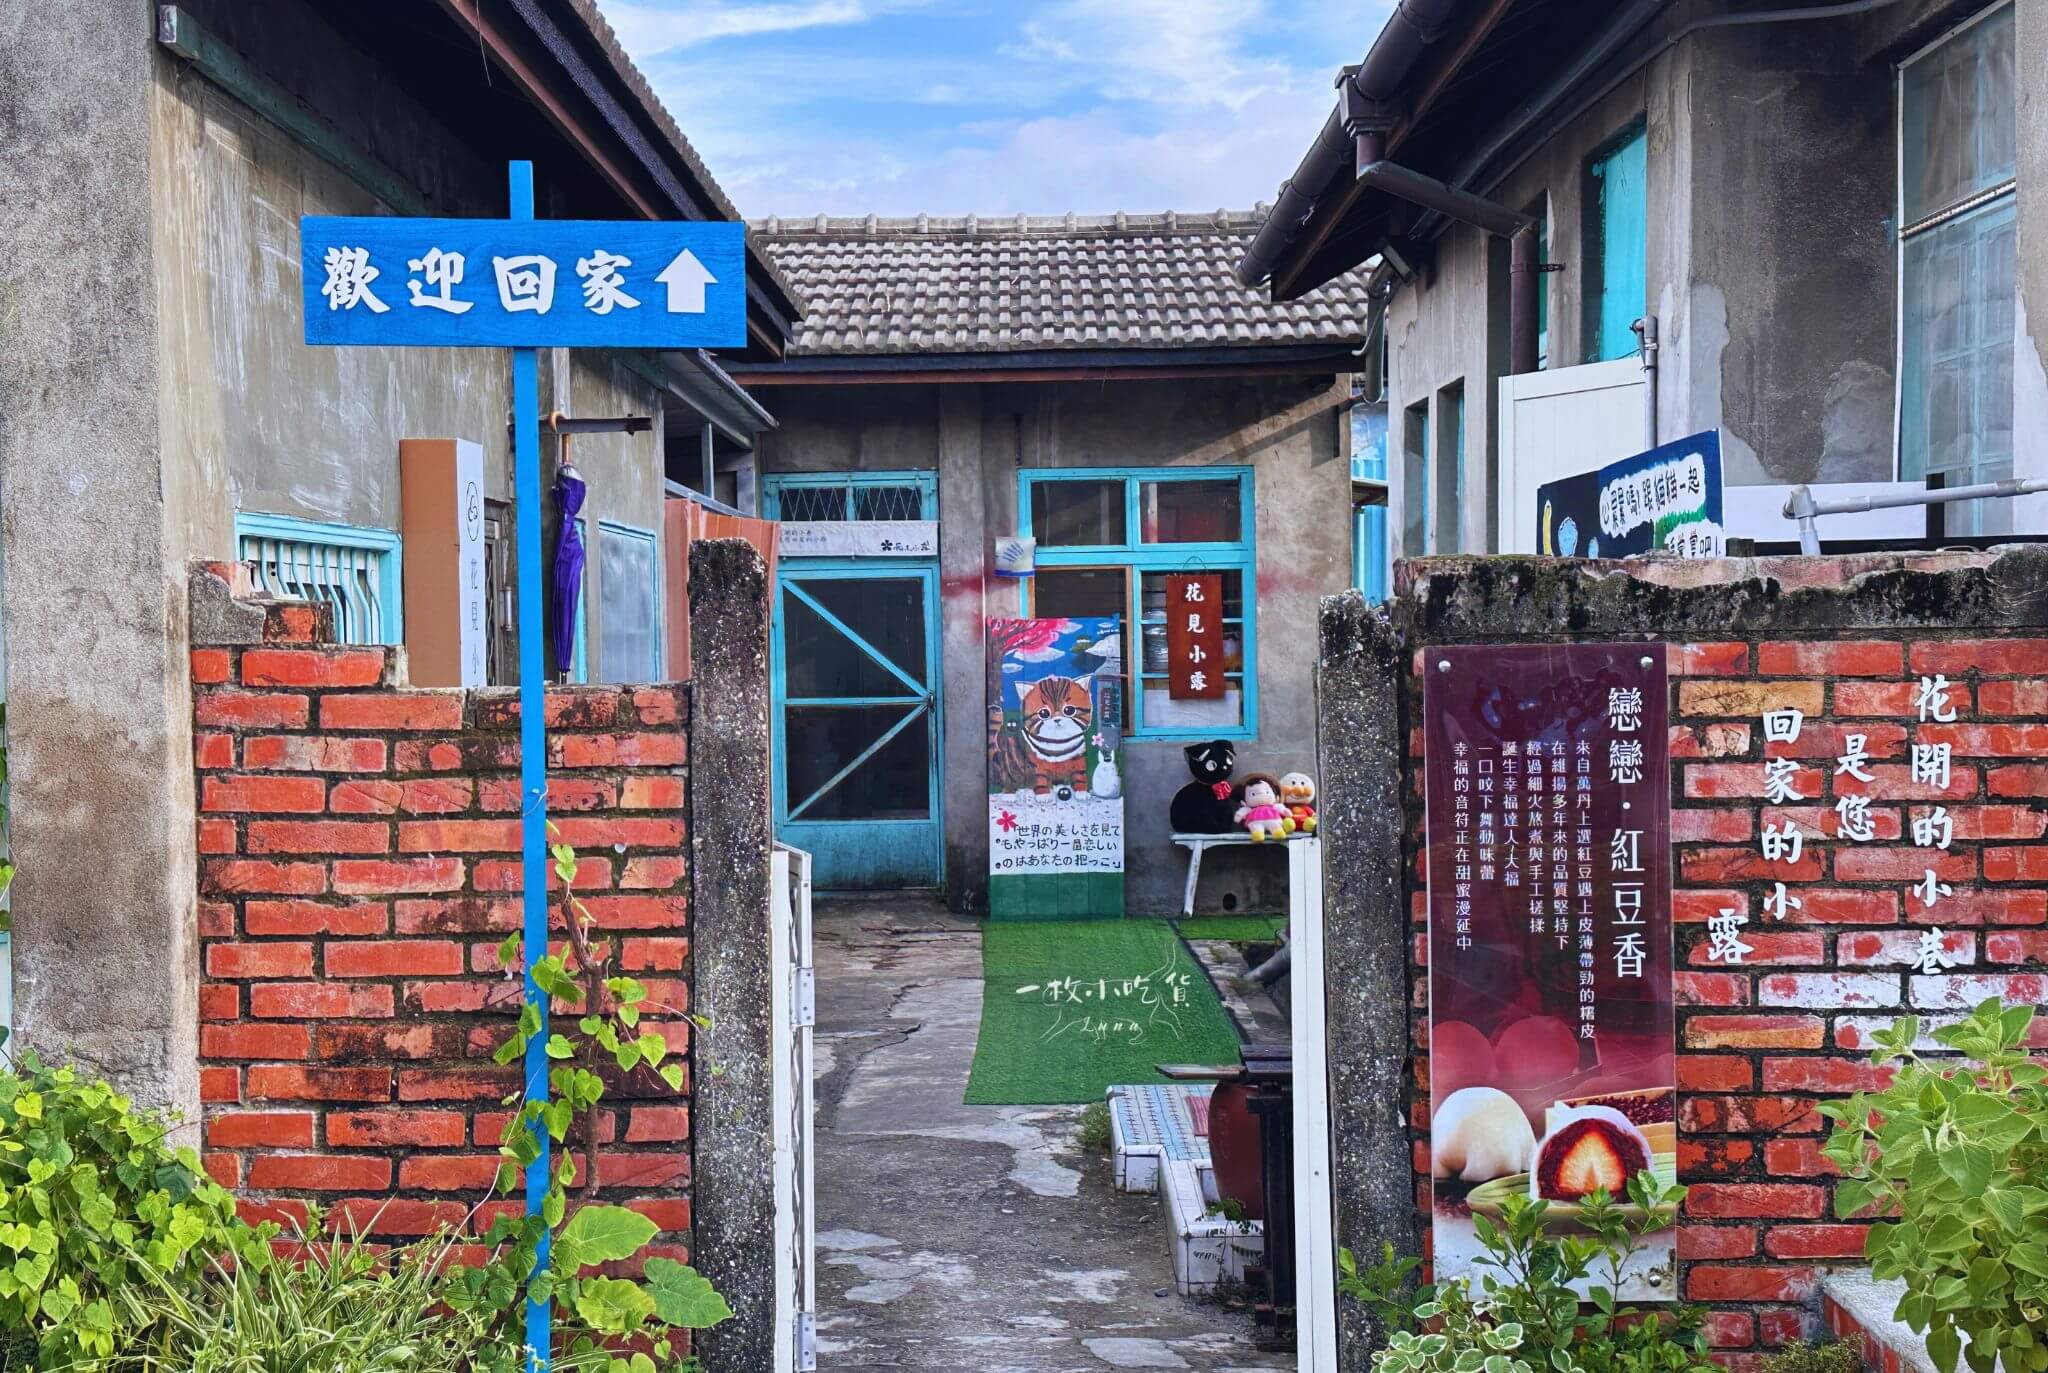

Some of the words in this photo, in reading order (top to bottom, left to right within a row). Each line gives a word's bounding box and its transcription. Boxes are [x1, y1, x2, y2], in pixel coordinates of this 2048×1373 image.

[321, 245, 640, 314] 歡迎回家
[470, 558, 479, 687] 花見小
[1184, 583, 1208, 691] 花見小露
[1477, 745, 1496, 882] 一口咬下舞動味蕾
[1835, 734, 1876, 843] 是您
[1911, 674, 1957, 975] 花開的小巷
